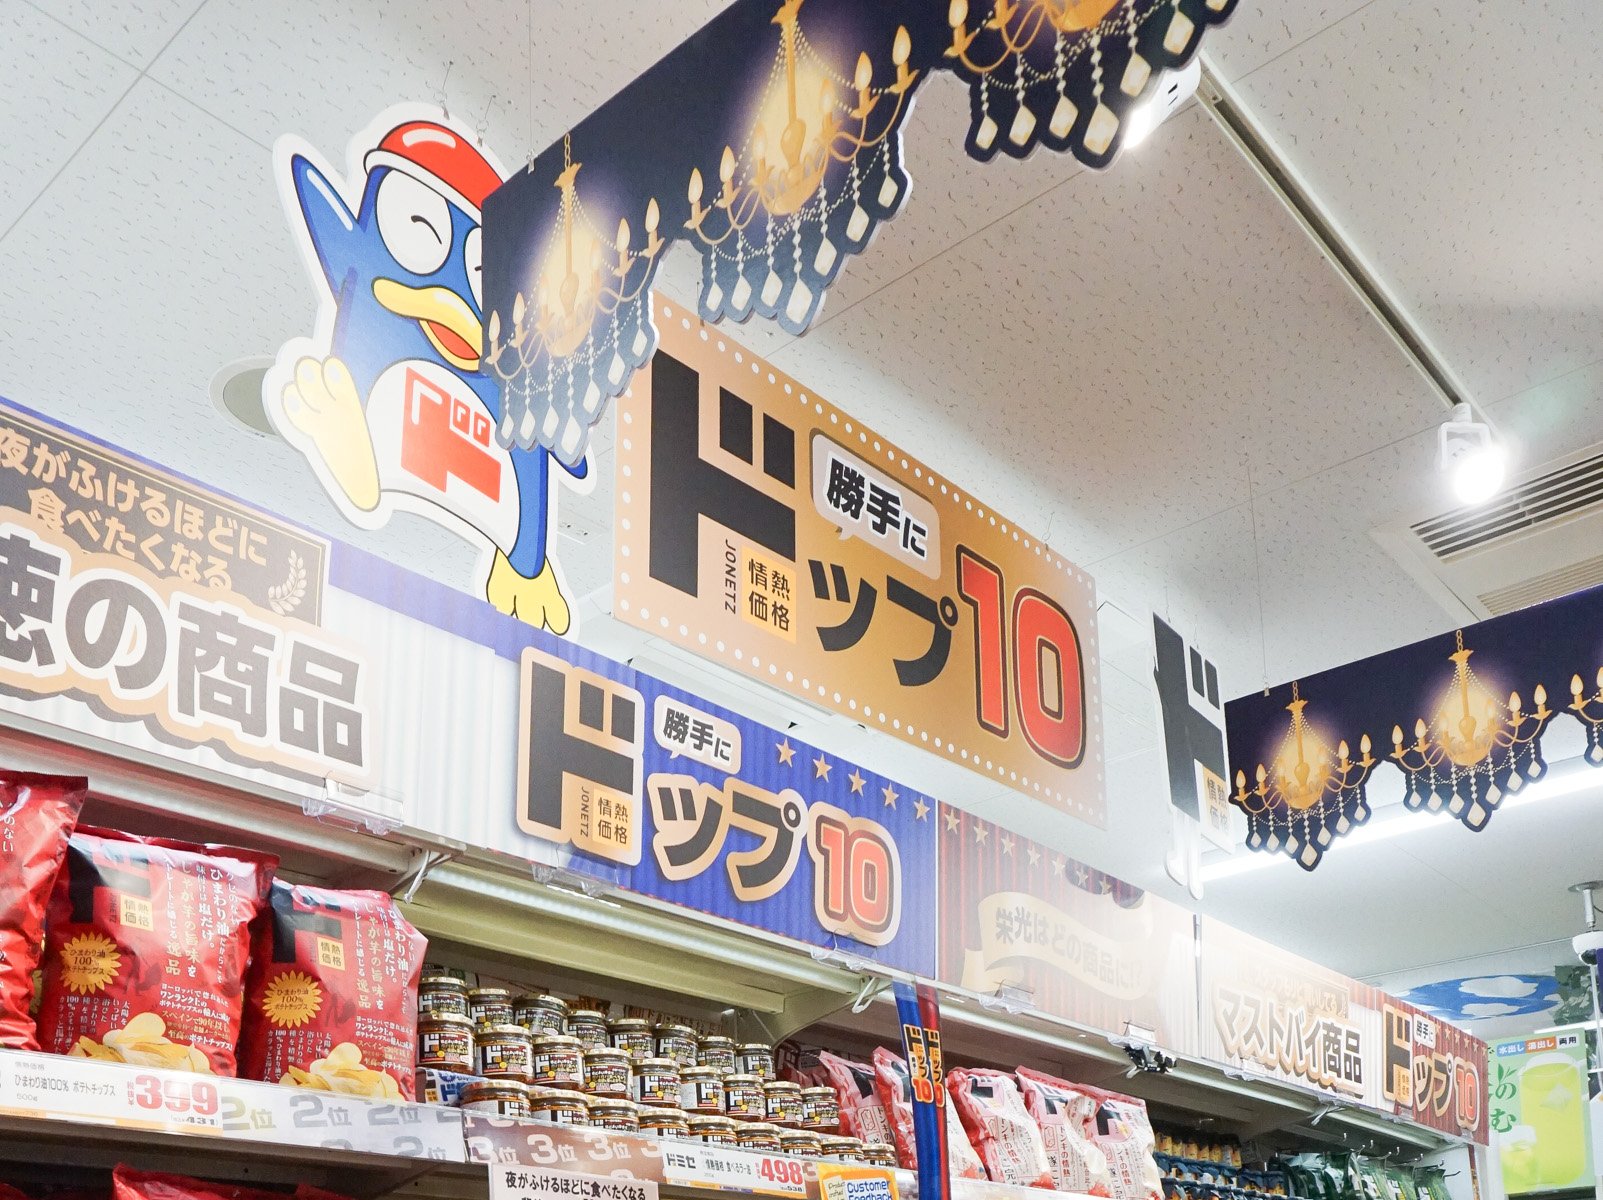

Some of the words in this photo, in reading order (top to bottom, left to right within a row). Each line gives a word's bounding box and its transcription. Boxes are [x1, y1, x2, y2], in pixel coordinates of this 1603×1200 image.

[0, 426, 269, 567] 夜がふけるほどに
[826, 455, 929, 560] 勝手に
[27, 487, 233, 591] 食べたくなる
[724, 538, 738, 615] JONETZ
[747, 557, 792, 601] 情熱
[747, 590, 791, 633] 価格
[663, 708, 732, 763] 勝手に
[580, 786, 590, 838] JONETZ
[597, 796, 629, 824] 情熱
[597, 819, 629, 847] 価格
[72, 1082, 116, 1097] ポテトチップス
[135, 1075, 219, 1116] 399
[760, 1158, 804, 1185] 498
[847, 1180, 891, 1194] Customer
